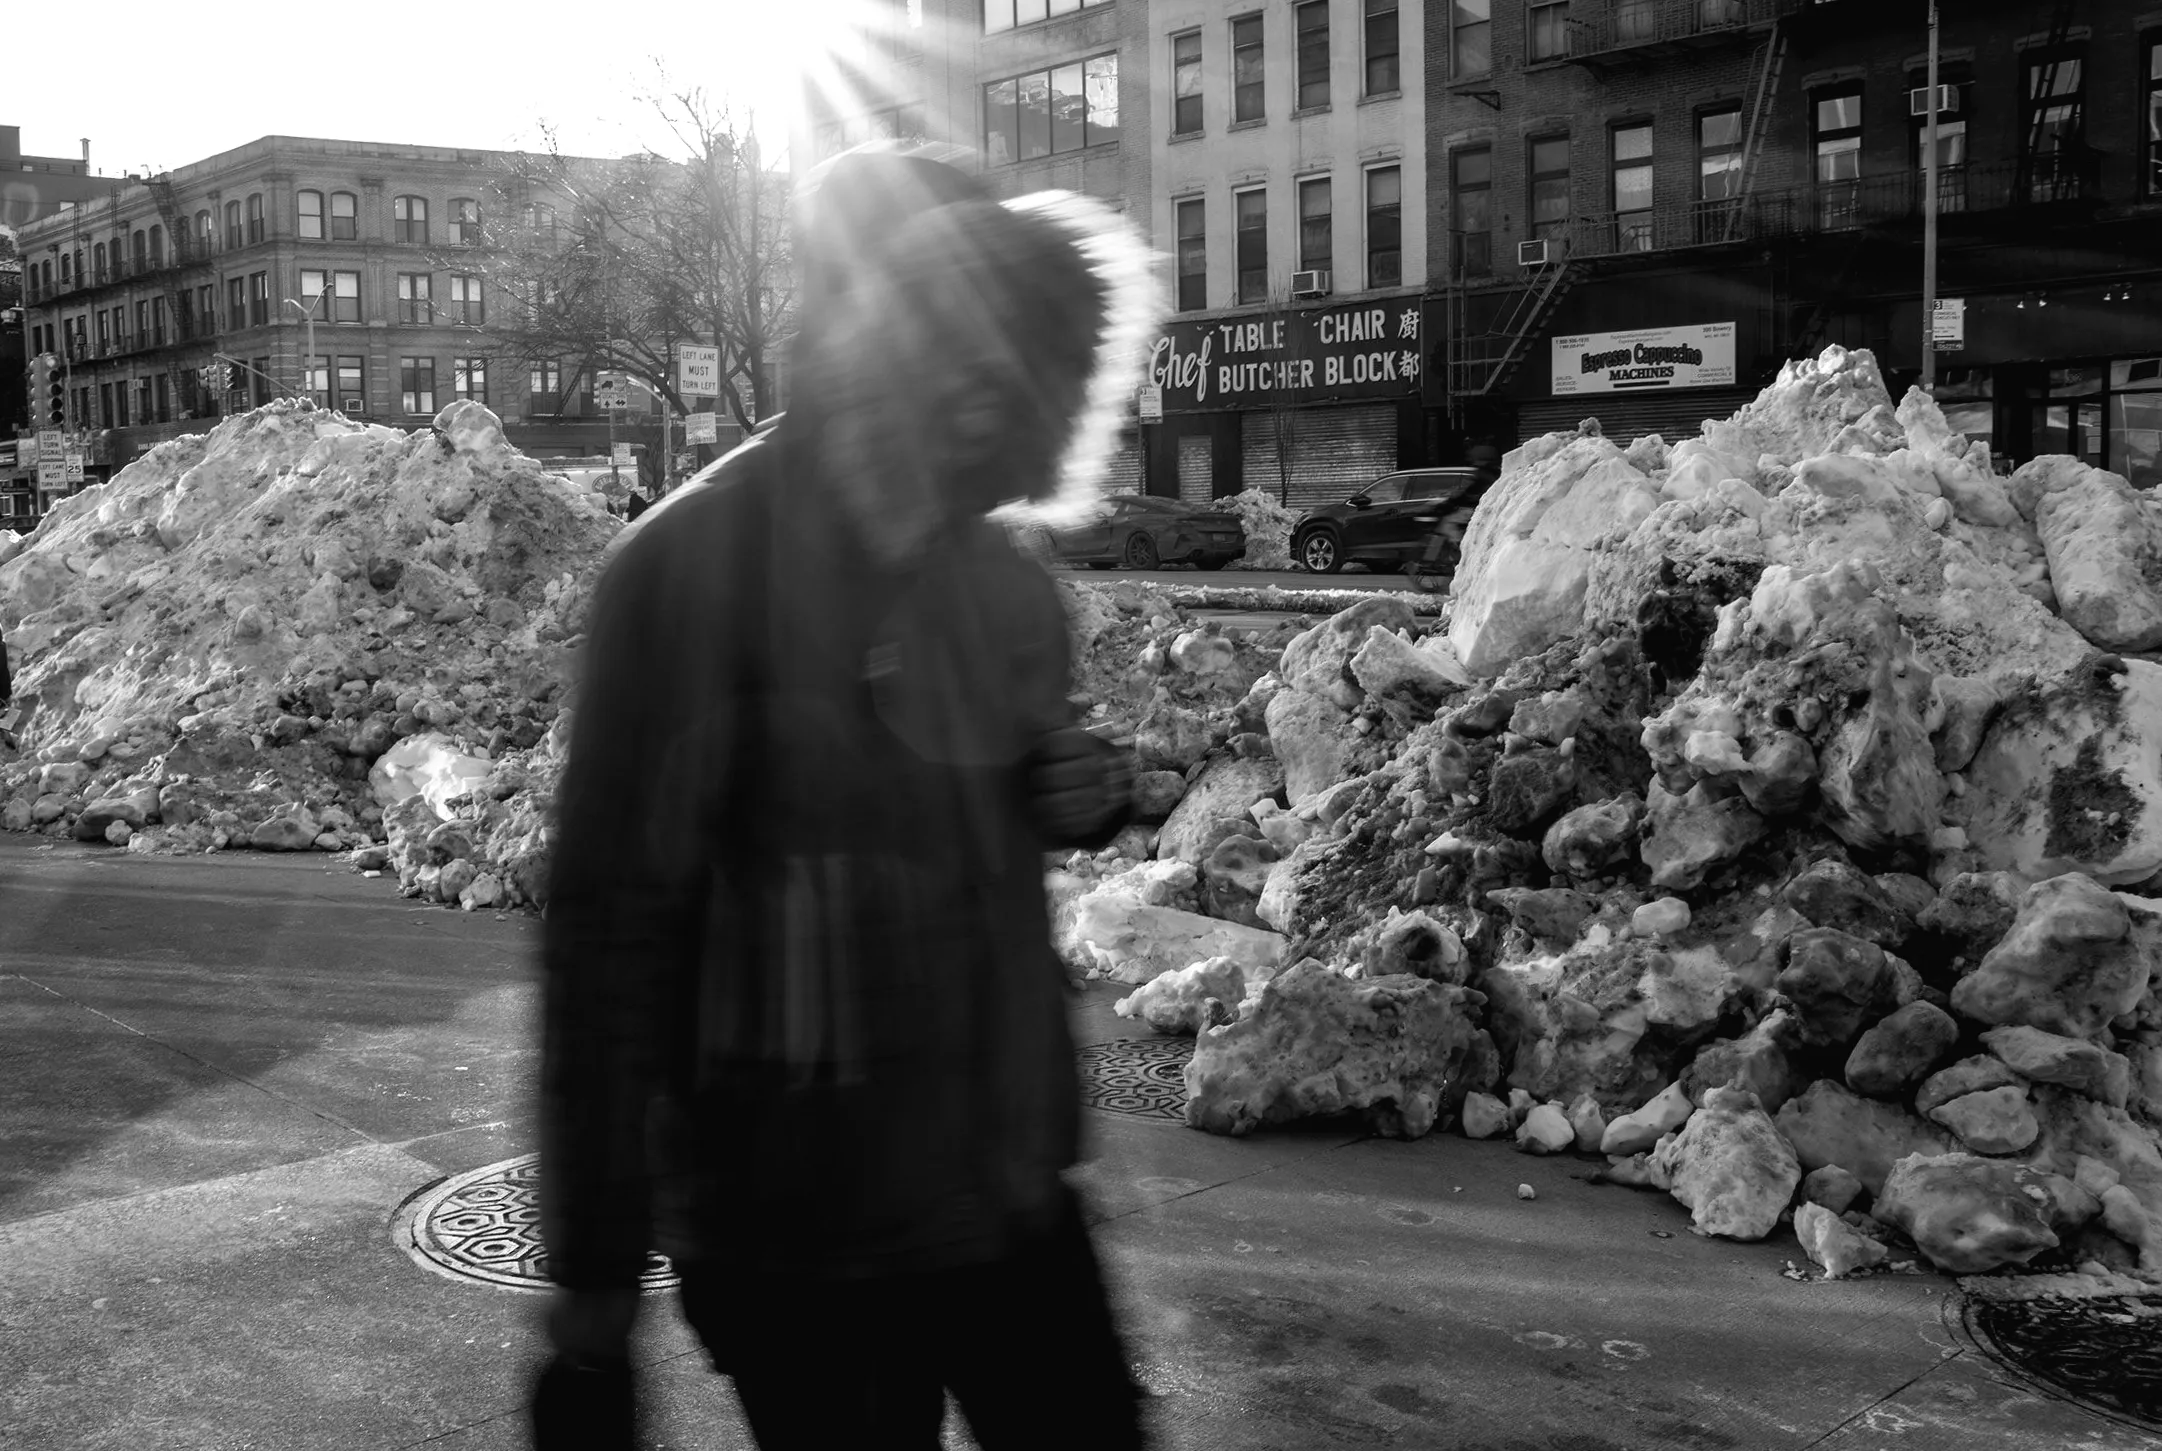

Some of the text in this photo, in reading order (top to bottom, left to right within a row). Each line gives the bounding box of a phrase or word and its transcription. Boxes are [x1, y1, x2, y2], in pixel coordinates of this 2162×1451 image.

[1221, 310, 1386, 353] TABLE CHAIR
[682, 351, 716, 362] LEFT LANE
[1581, 343, 1703, 374] Espresso Cappuccino
[688, 365, 709, 377] MUST
[1150, 332, 1212, 403] Chef
[1219, 351, 1398, 394] BUTCHER BLOCK
[1608, 366, 1675, 381] MACHINES
[682, 379, 716, 390] TURN LEFT
[68, 465, 82, 474] 25
